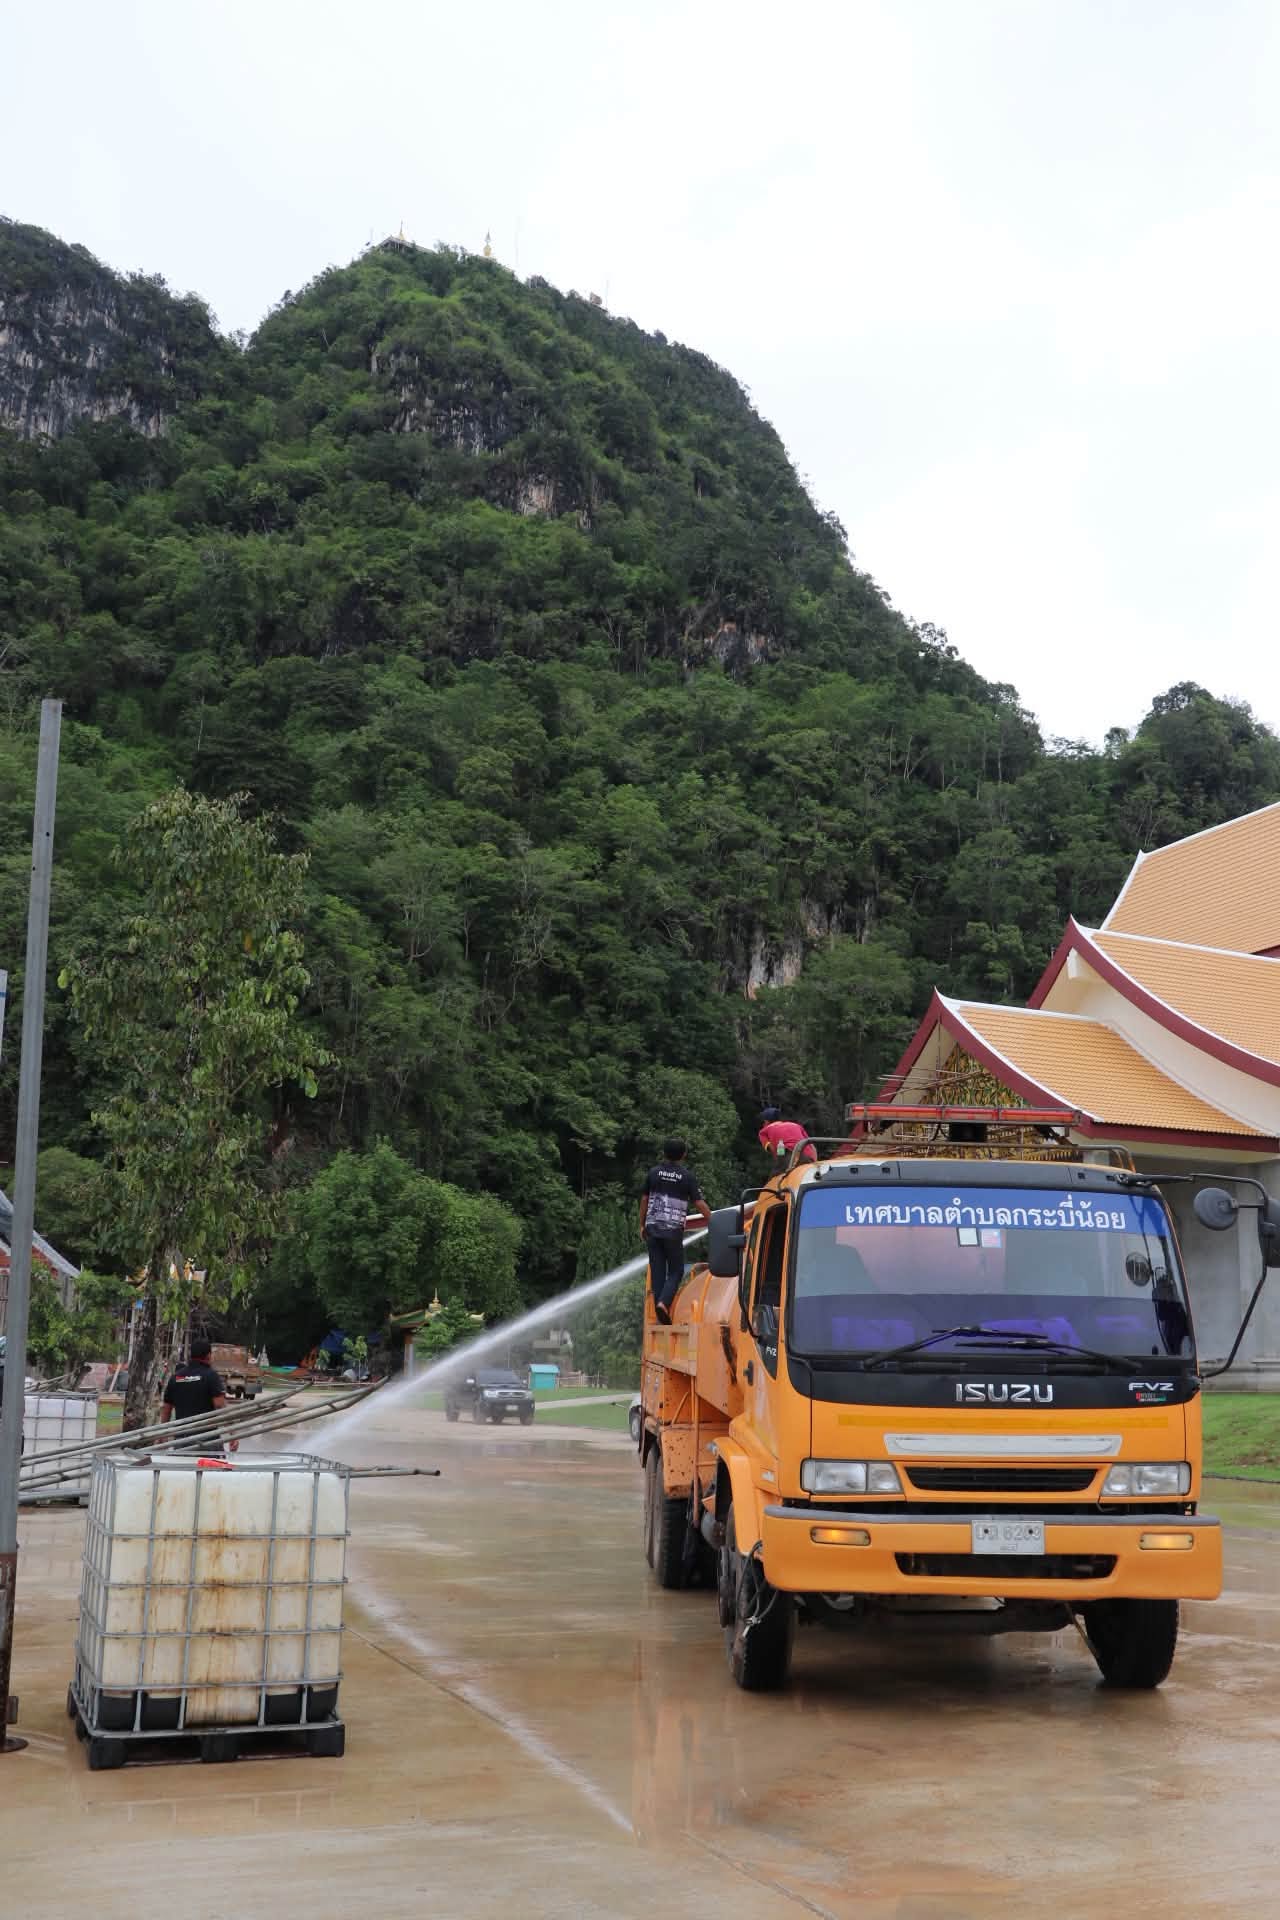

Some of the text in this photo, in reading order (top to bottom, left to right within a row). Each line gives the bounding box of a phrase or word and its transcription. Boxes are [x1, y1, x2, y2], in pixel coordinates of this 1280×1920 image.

[845, 1194, 1127, 1230] เทศบาลตำบลกระบี่น้อย
[956, 1383, 1054, 1403] ISUZU
[1128, 1382, 1175, 1392] FVZ
